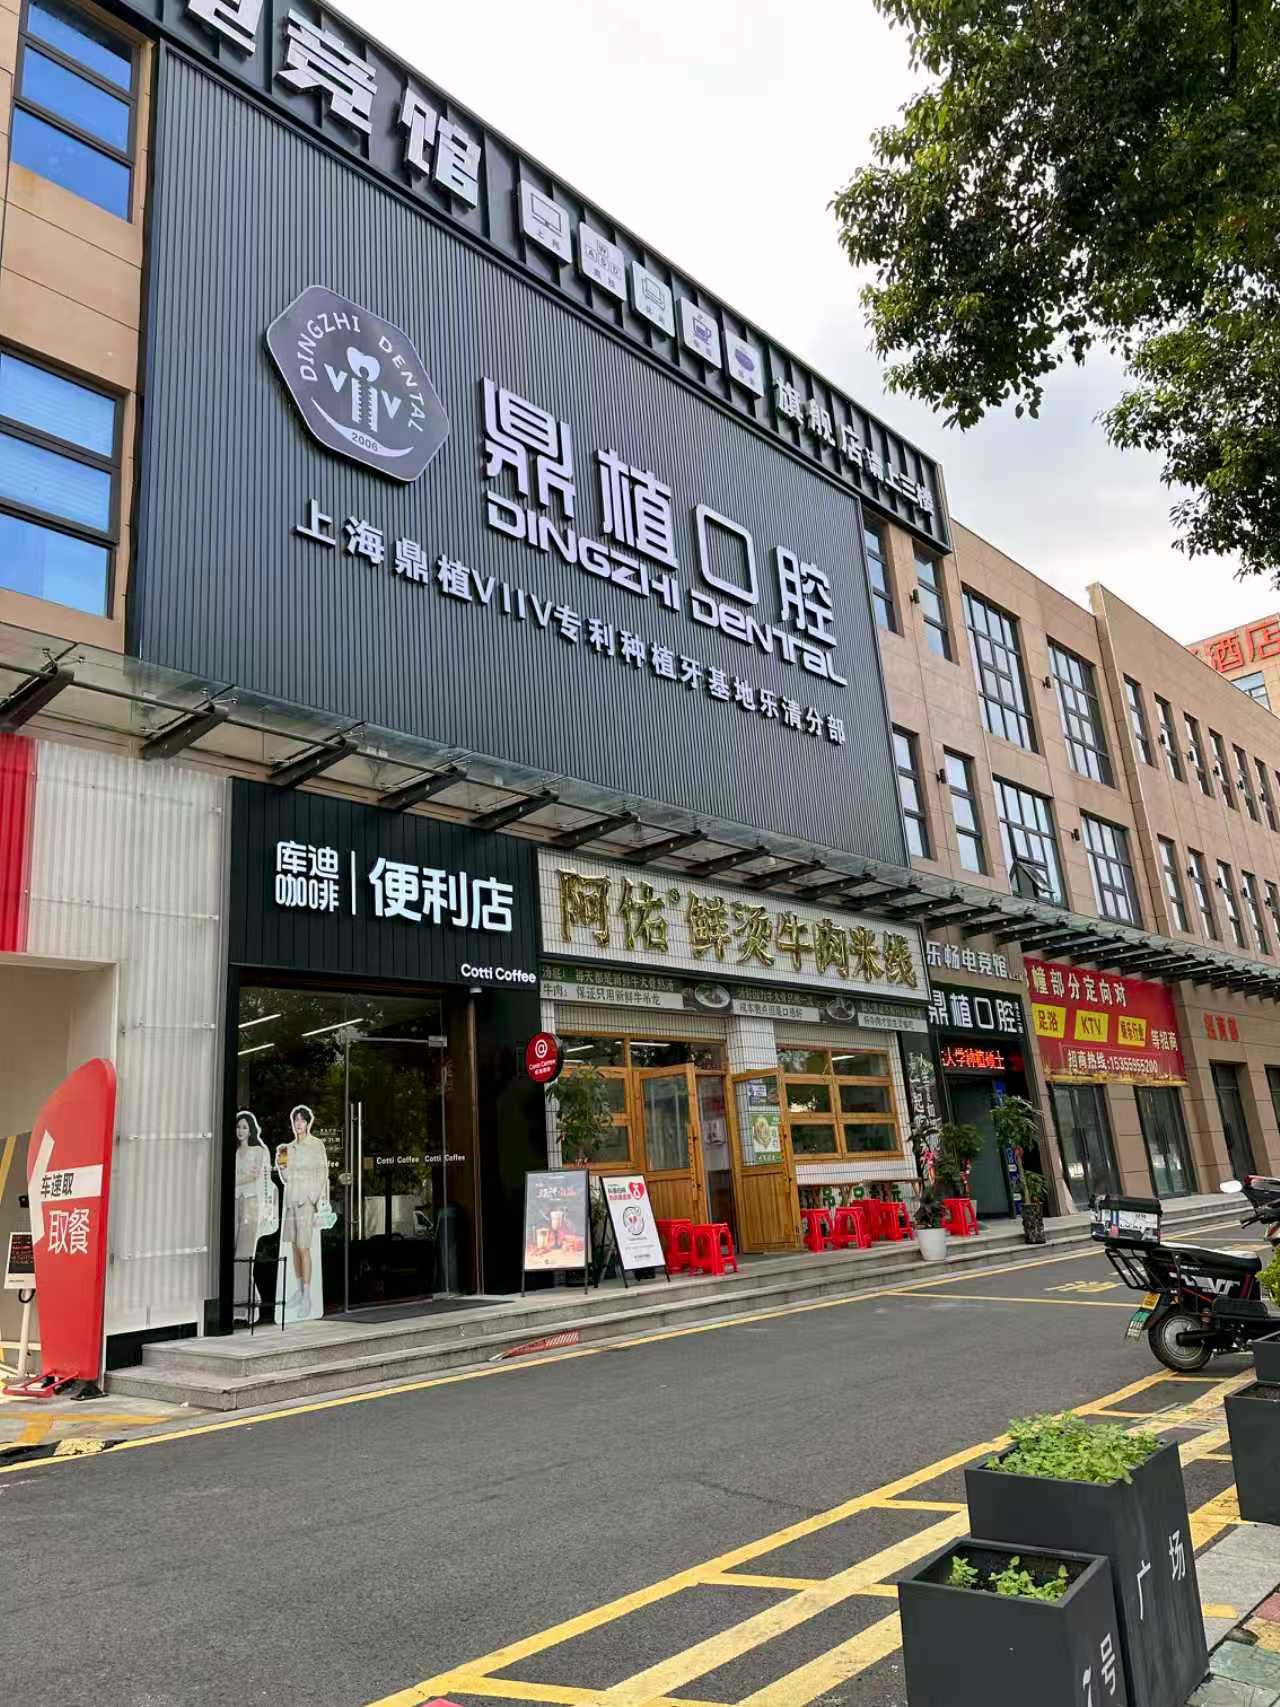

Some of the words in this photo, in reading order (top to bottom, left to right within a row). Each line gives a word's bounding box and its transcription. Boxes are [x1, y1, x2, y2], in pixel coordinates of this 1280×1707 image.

[297, 311, 361, 383] DINGZHI
[377, 334, 426, 434] DENTAL
[351, 431, 379, 453] 2006
[482, 375, 836, 648] 鼎植口腔
[486, 490, 681, 613] DINGZHI
[296, 497, 847, 746] 上海鼎植VIIV专利种植牙基地乐清分部
[275, 840, 339, 876] 库迪
[275, 873, 339, 913] 咖啡
[368, 857, 514, 934] 便利店
[461, 963, 493, 981] Cotti
[495, 967, 537, 984] Coffee
[928, 989, 1018, 1034] 鼎植口腔
[1080, 1015, 1102, 1036] KTV
[376, 1157, 395, 1165] Cotti
[397, 1156, 420, 1164] Coffee
[424, 1155, 442, 1163] Cotti
[40, 1172, 74, 1199] 车速取
[48, 1206, 90, 1256] 取餐
[1136, 1529, 1186, 1621] 广场
